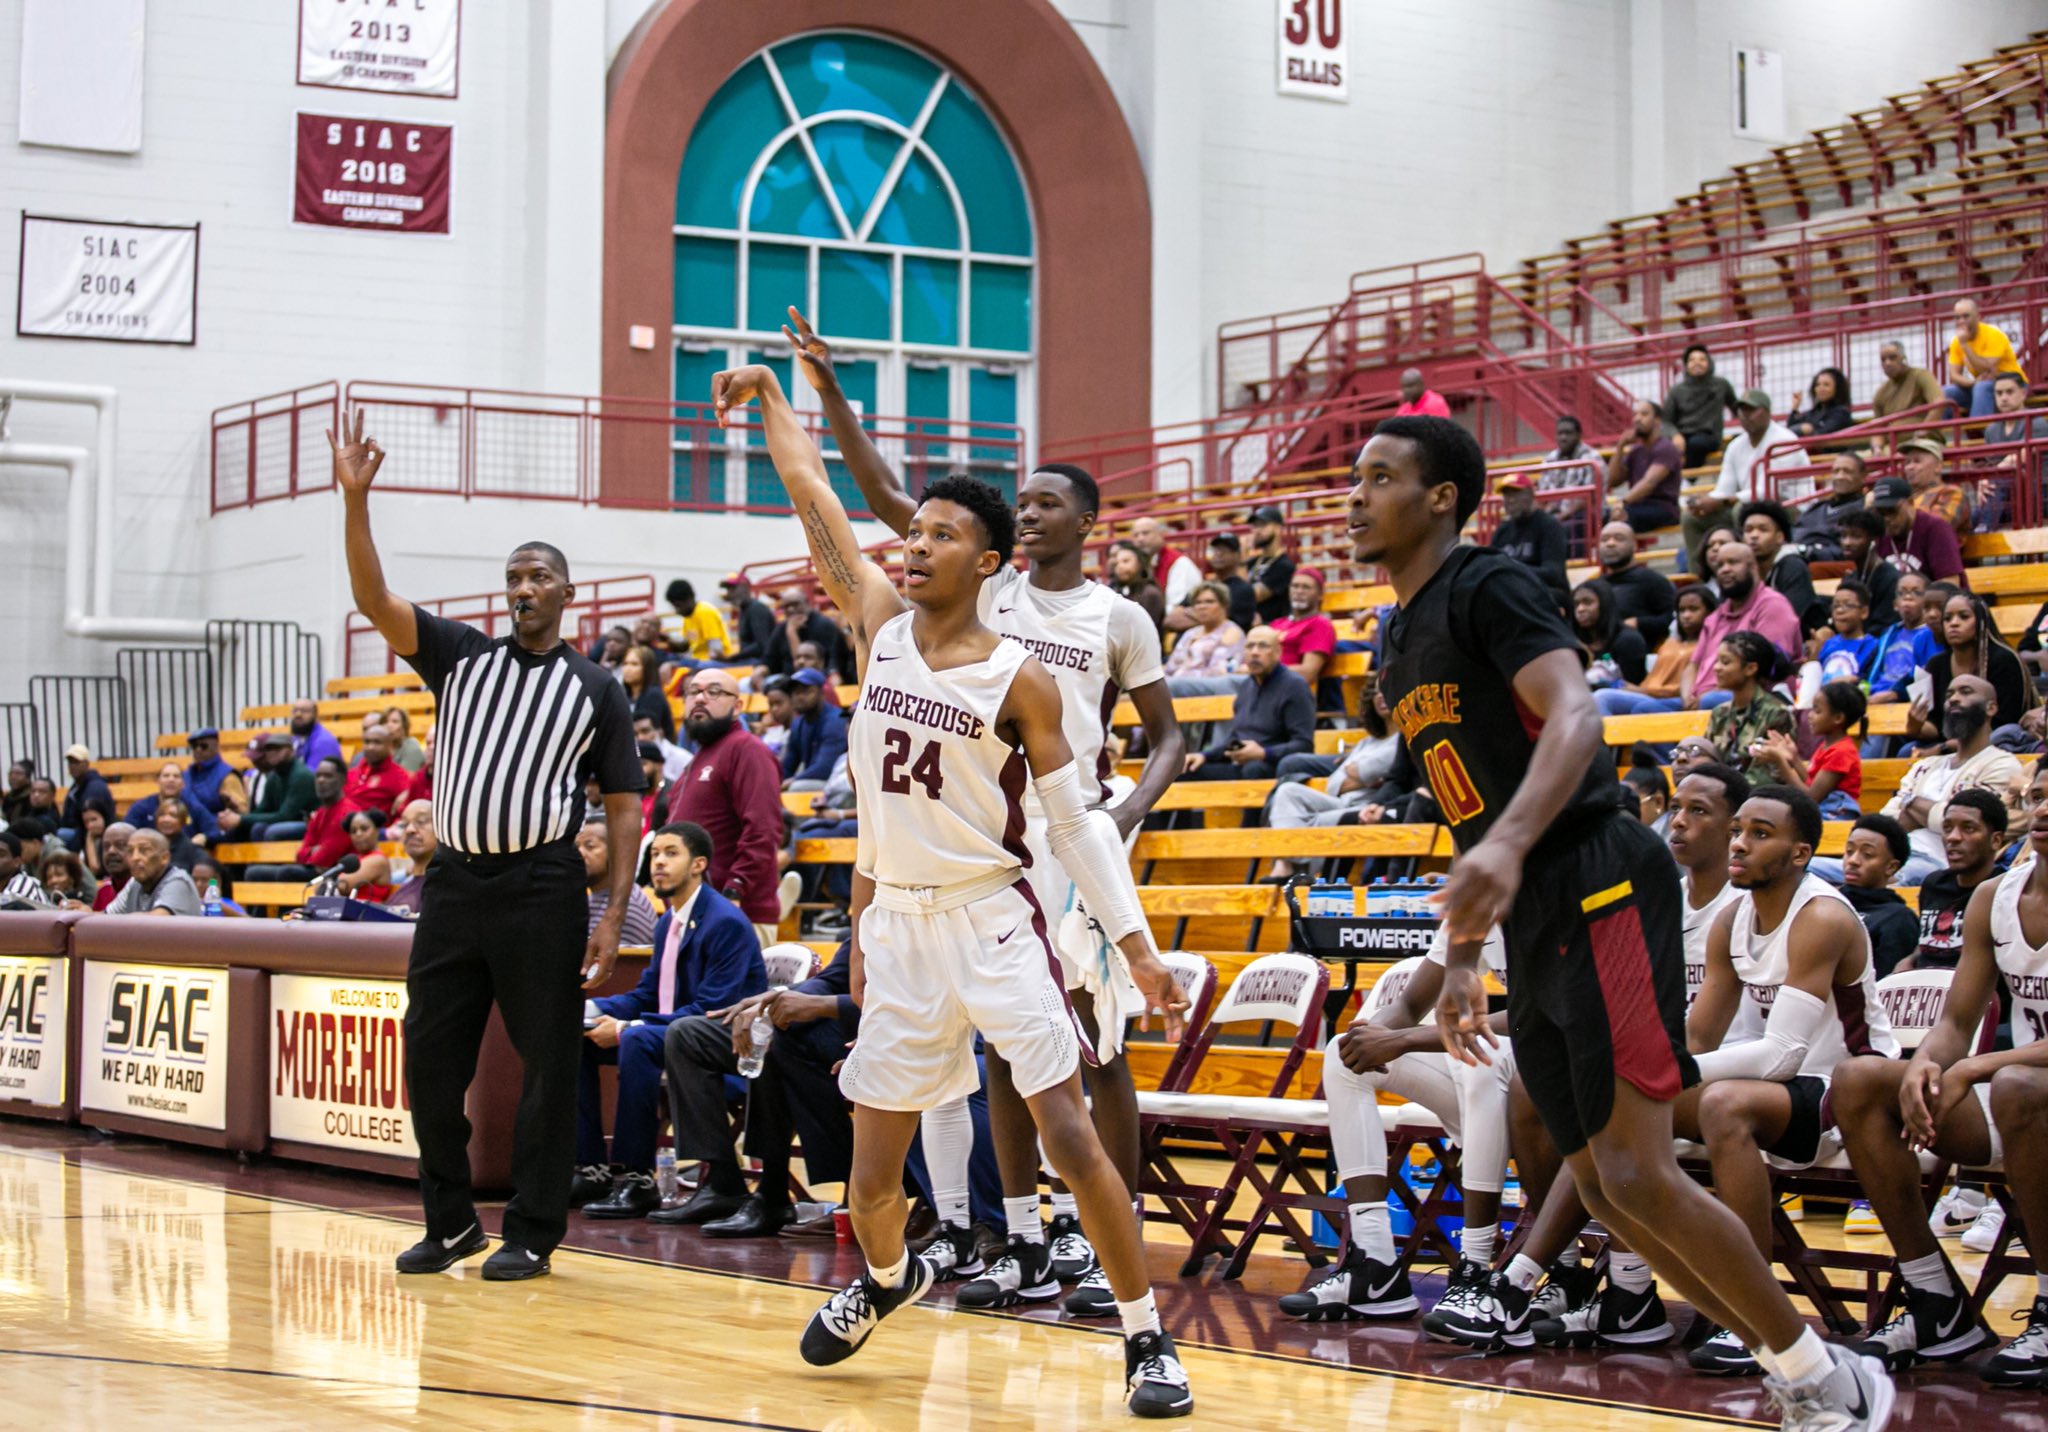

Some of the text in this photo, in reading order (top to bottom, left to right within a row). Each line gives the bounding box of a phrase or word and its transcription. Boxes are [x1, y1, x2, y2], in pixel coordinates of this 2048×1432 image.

[350, 20, 411, 43] 2013
[1286, 0, 1341, 49] 30
[1287, 57, 1342, 87] ELLIS
[327, 123, 421, 152] SIAC
[341, 159, 406, 185] 2018
[83, 236, 138, 259] SIAC
[81, 274, 136, 296] 2004
[66, 311, 149, 328] CHAMPIONS
[864, 684, 985, 740] MOREHOUSE
[881, 727, 944, 800] 24
[1423, 738, 1484, 827] 10
[331, 989, 400, 1010] WELCOME TO
[105, 980, 210, 1056] SIAC
[8, 1047, 41, 1070] HARD
[102, 1059, 204, 1094] WE PLAY HARD
[127, 1092, 188, 1115] www.thesiac.com
[325, 1111, 403, 1144] COLLEGE
